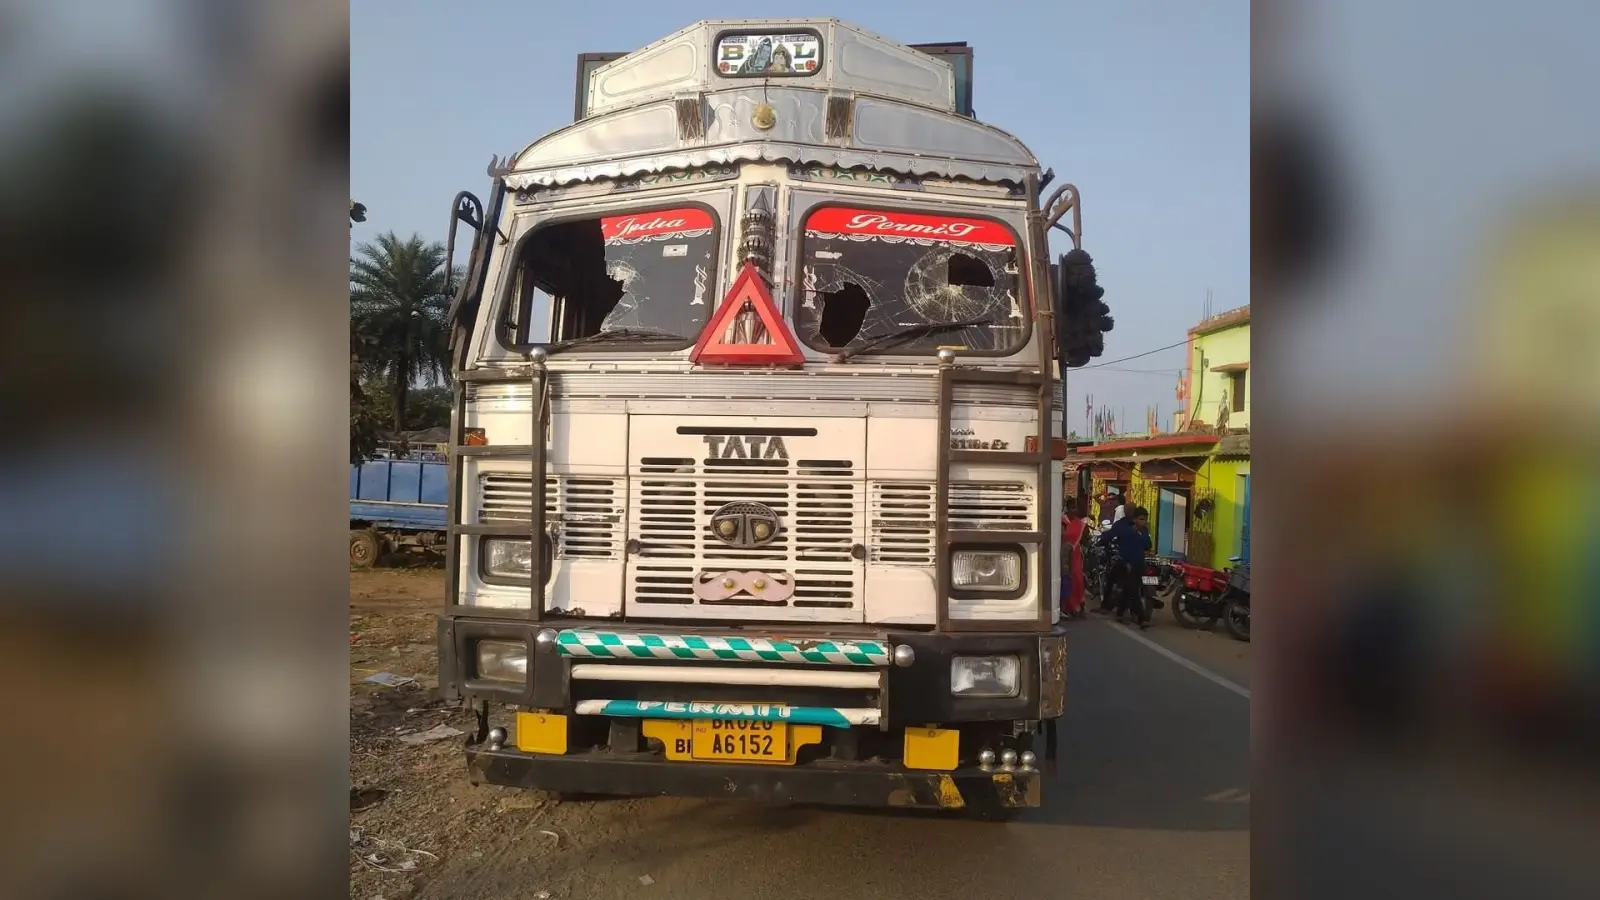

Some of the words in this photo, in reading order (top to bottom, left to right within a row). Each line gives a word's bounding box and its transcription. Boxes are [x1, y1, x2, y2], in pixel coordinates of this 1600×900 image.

[720, 45, 744, 60] B
[793, 43, 817, 58] L
[611, 217, 686, 239] India
[703, 435, 789, 459] TATA
[636, 700, 799, 718] PERMIT
[712, 733, 773, 755] A6152
